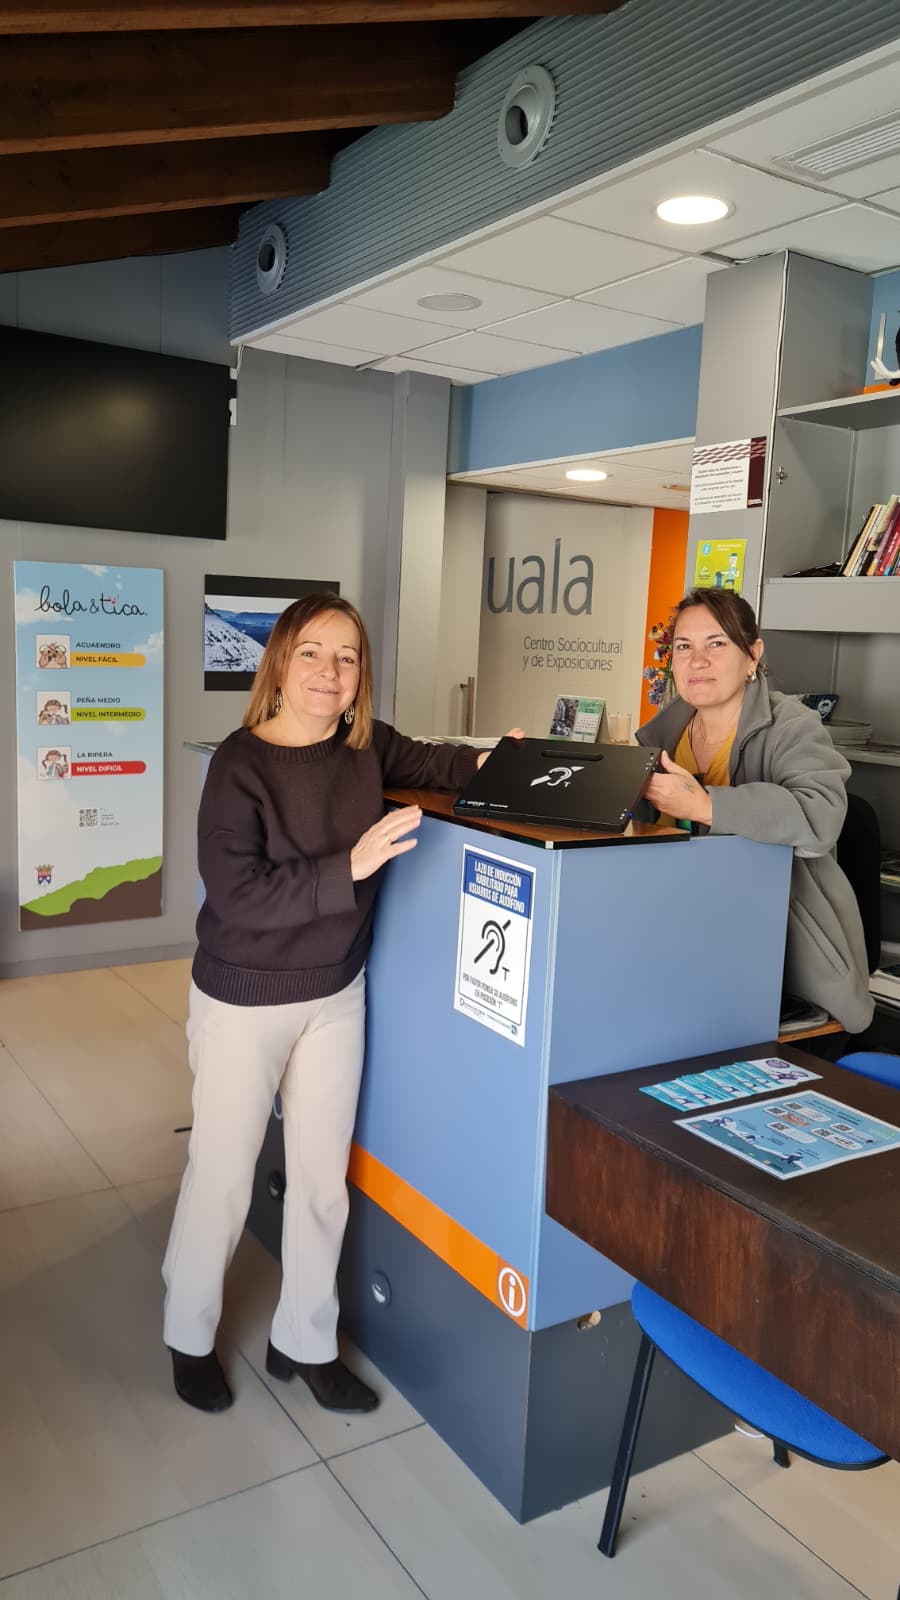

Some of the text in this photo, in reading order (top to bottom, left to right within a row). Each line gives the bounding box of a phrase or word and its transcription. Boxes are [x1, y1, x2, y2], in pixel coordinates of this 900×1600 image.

[487, 537, 594, 616] uala
[523, 636, 624, 655] Centro Sociocultural
[522, 654, 613, 673] y de Exposiciones
[76, 696, 97, 704] PEÑA
